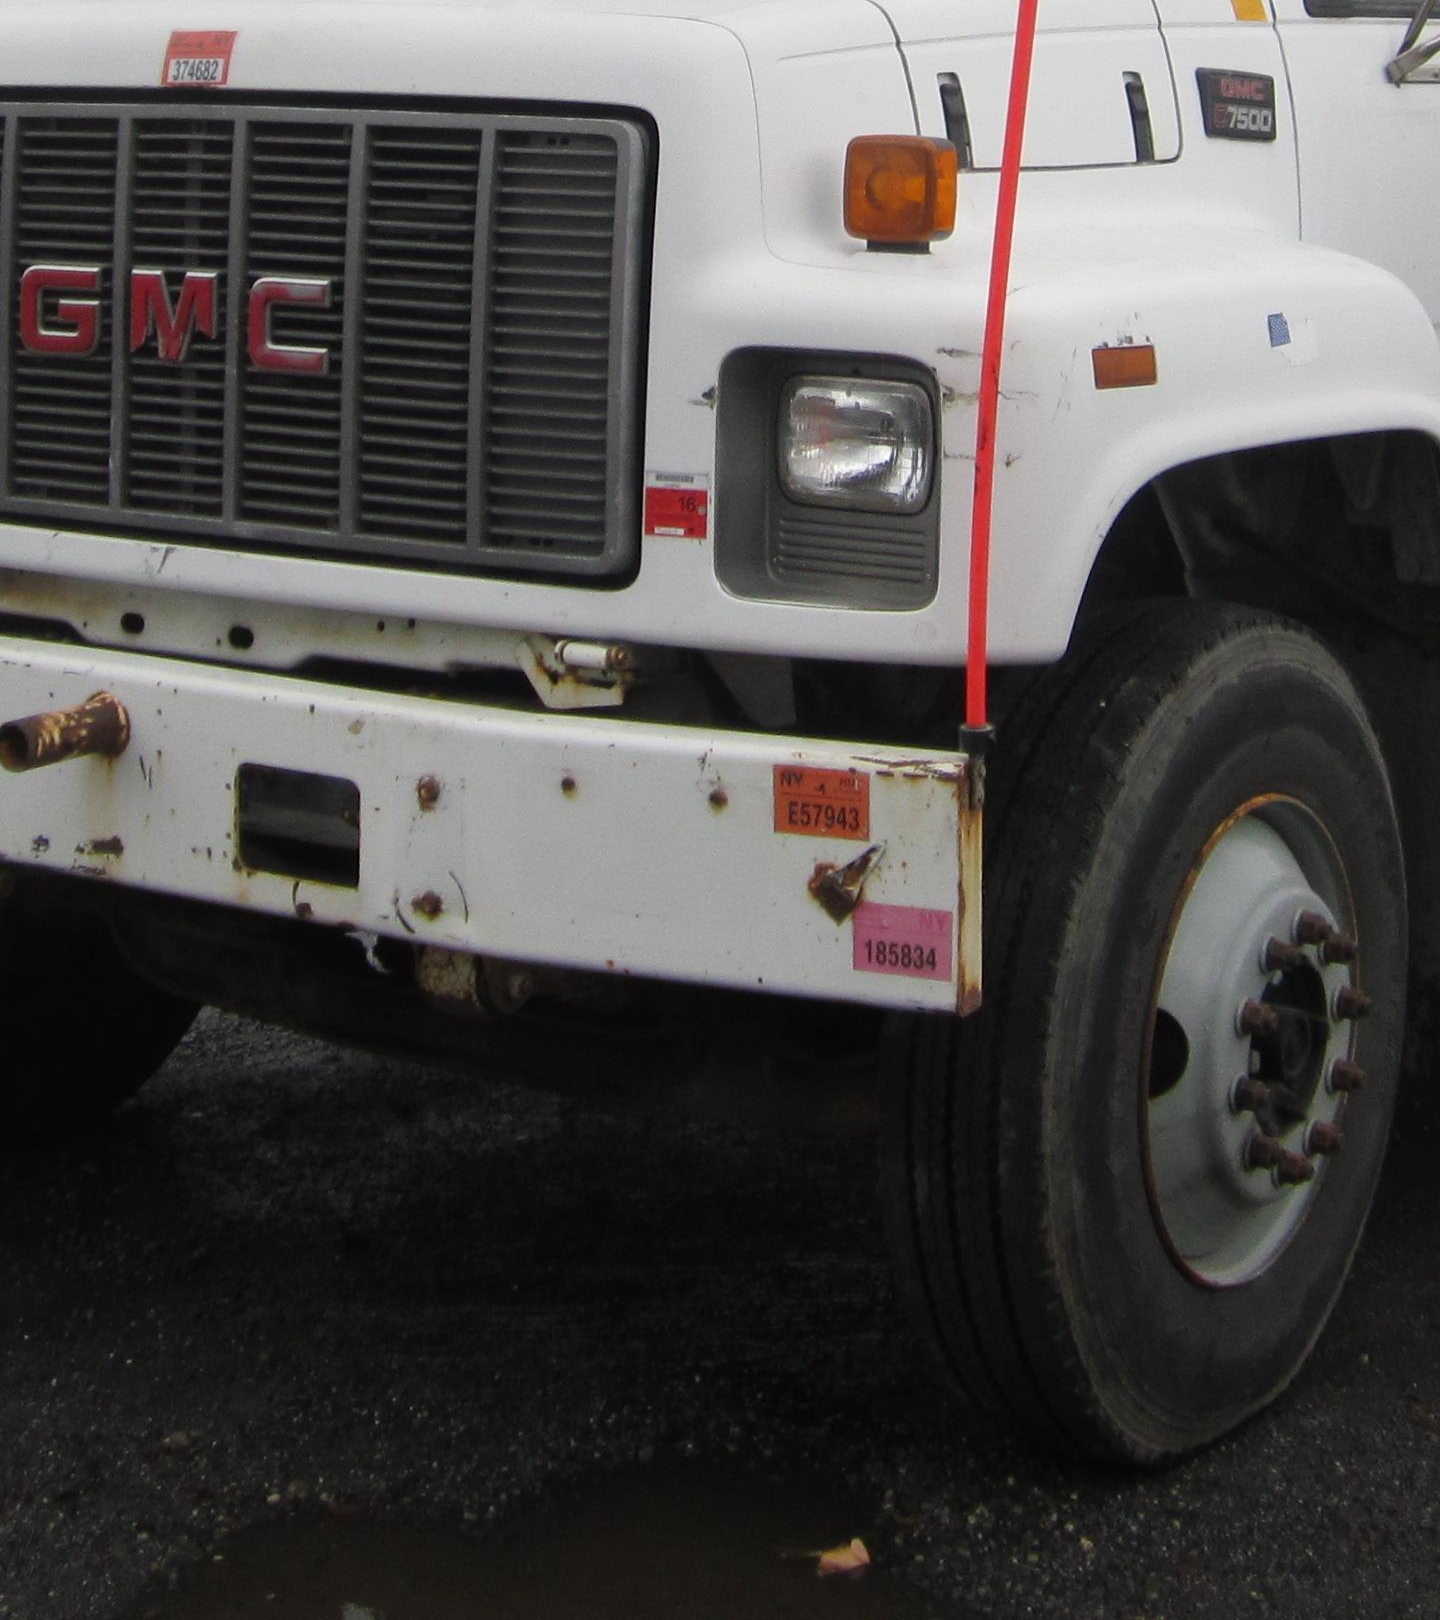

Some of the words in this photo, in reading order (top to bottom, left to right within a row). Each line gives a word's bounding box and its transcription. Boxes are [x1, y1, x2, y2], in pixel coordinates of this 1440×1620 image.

[172, 59, 220, 81] 374682
[1221, 77, 1265, 101] GMC
[18, 264, 329, 376] GMC
[680, 496, 697, 512] 16
[780, 772, 803, 787] NY
[787, 800, 860, 832] E57943
[920, 912, 948, 931] NY
[864, 938, 937, 971] 185834
